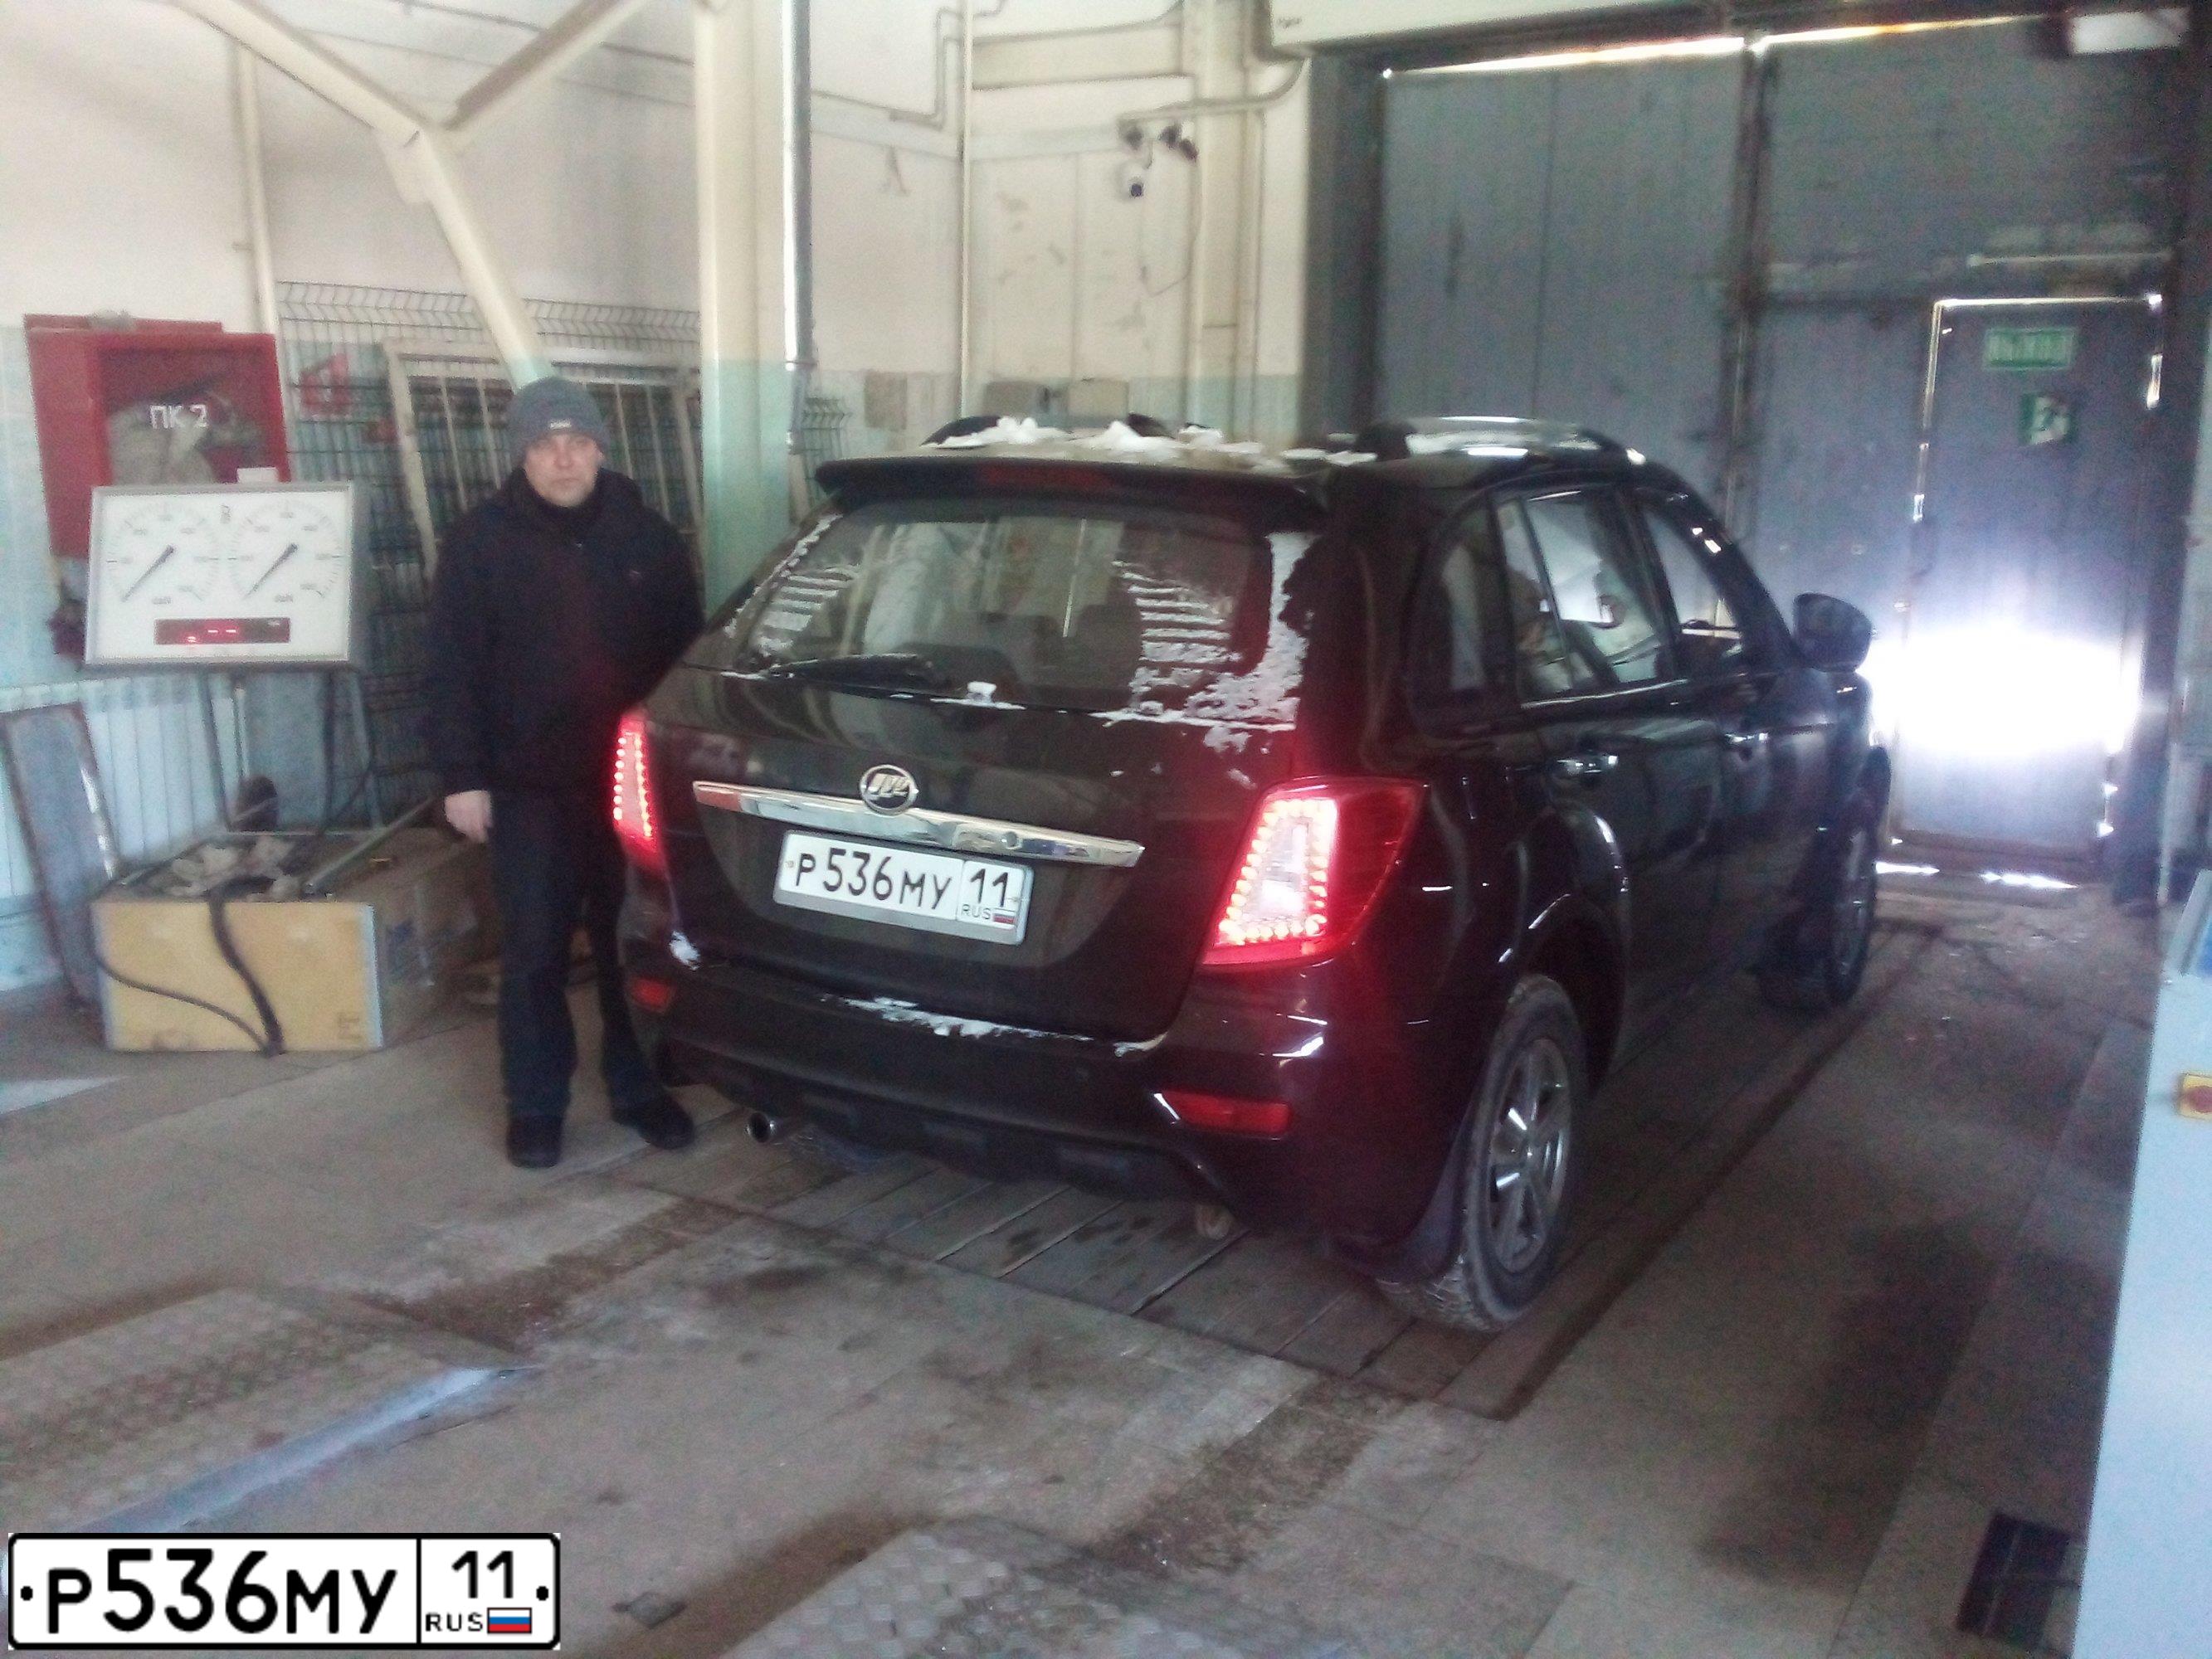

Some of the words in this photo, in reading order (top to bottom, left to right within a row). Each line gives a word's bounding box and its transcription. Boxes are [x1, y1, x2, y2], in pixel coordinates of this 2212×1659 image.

[796, 848, 952, 909] Р536МУ
[969, 868, 1009, 908] 11
[961, 903, 992, 921] RUS
